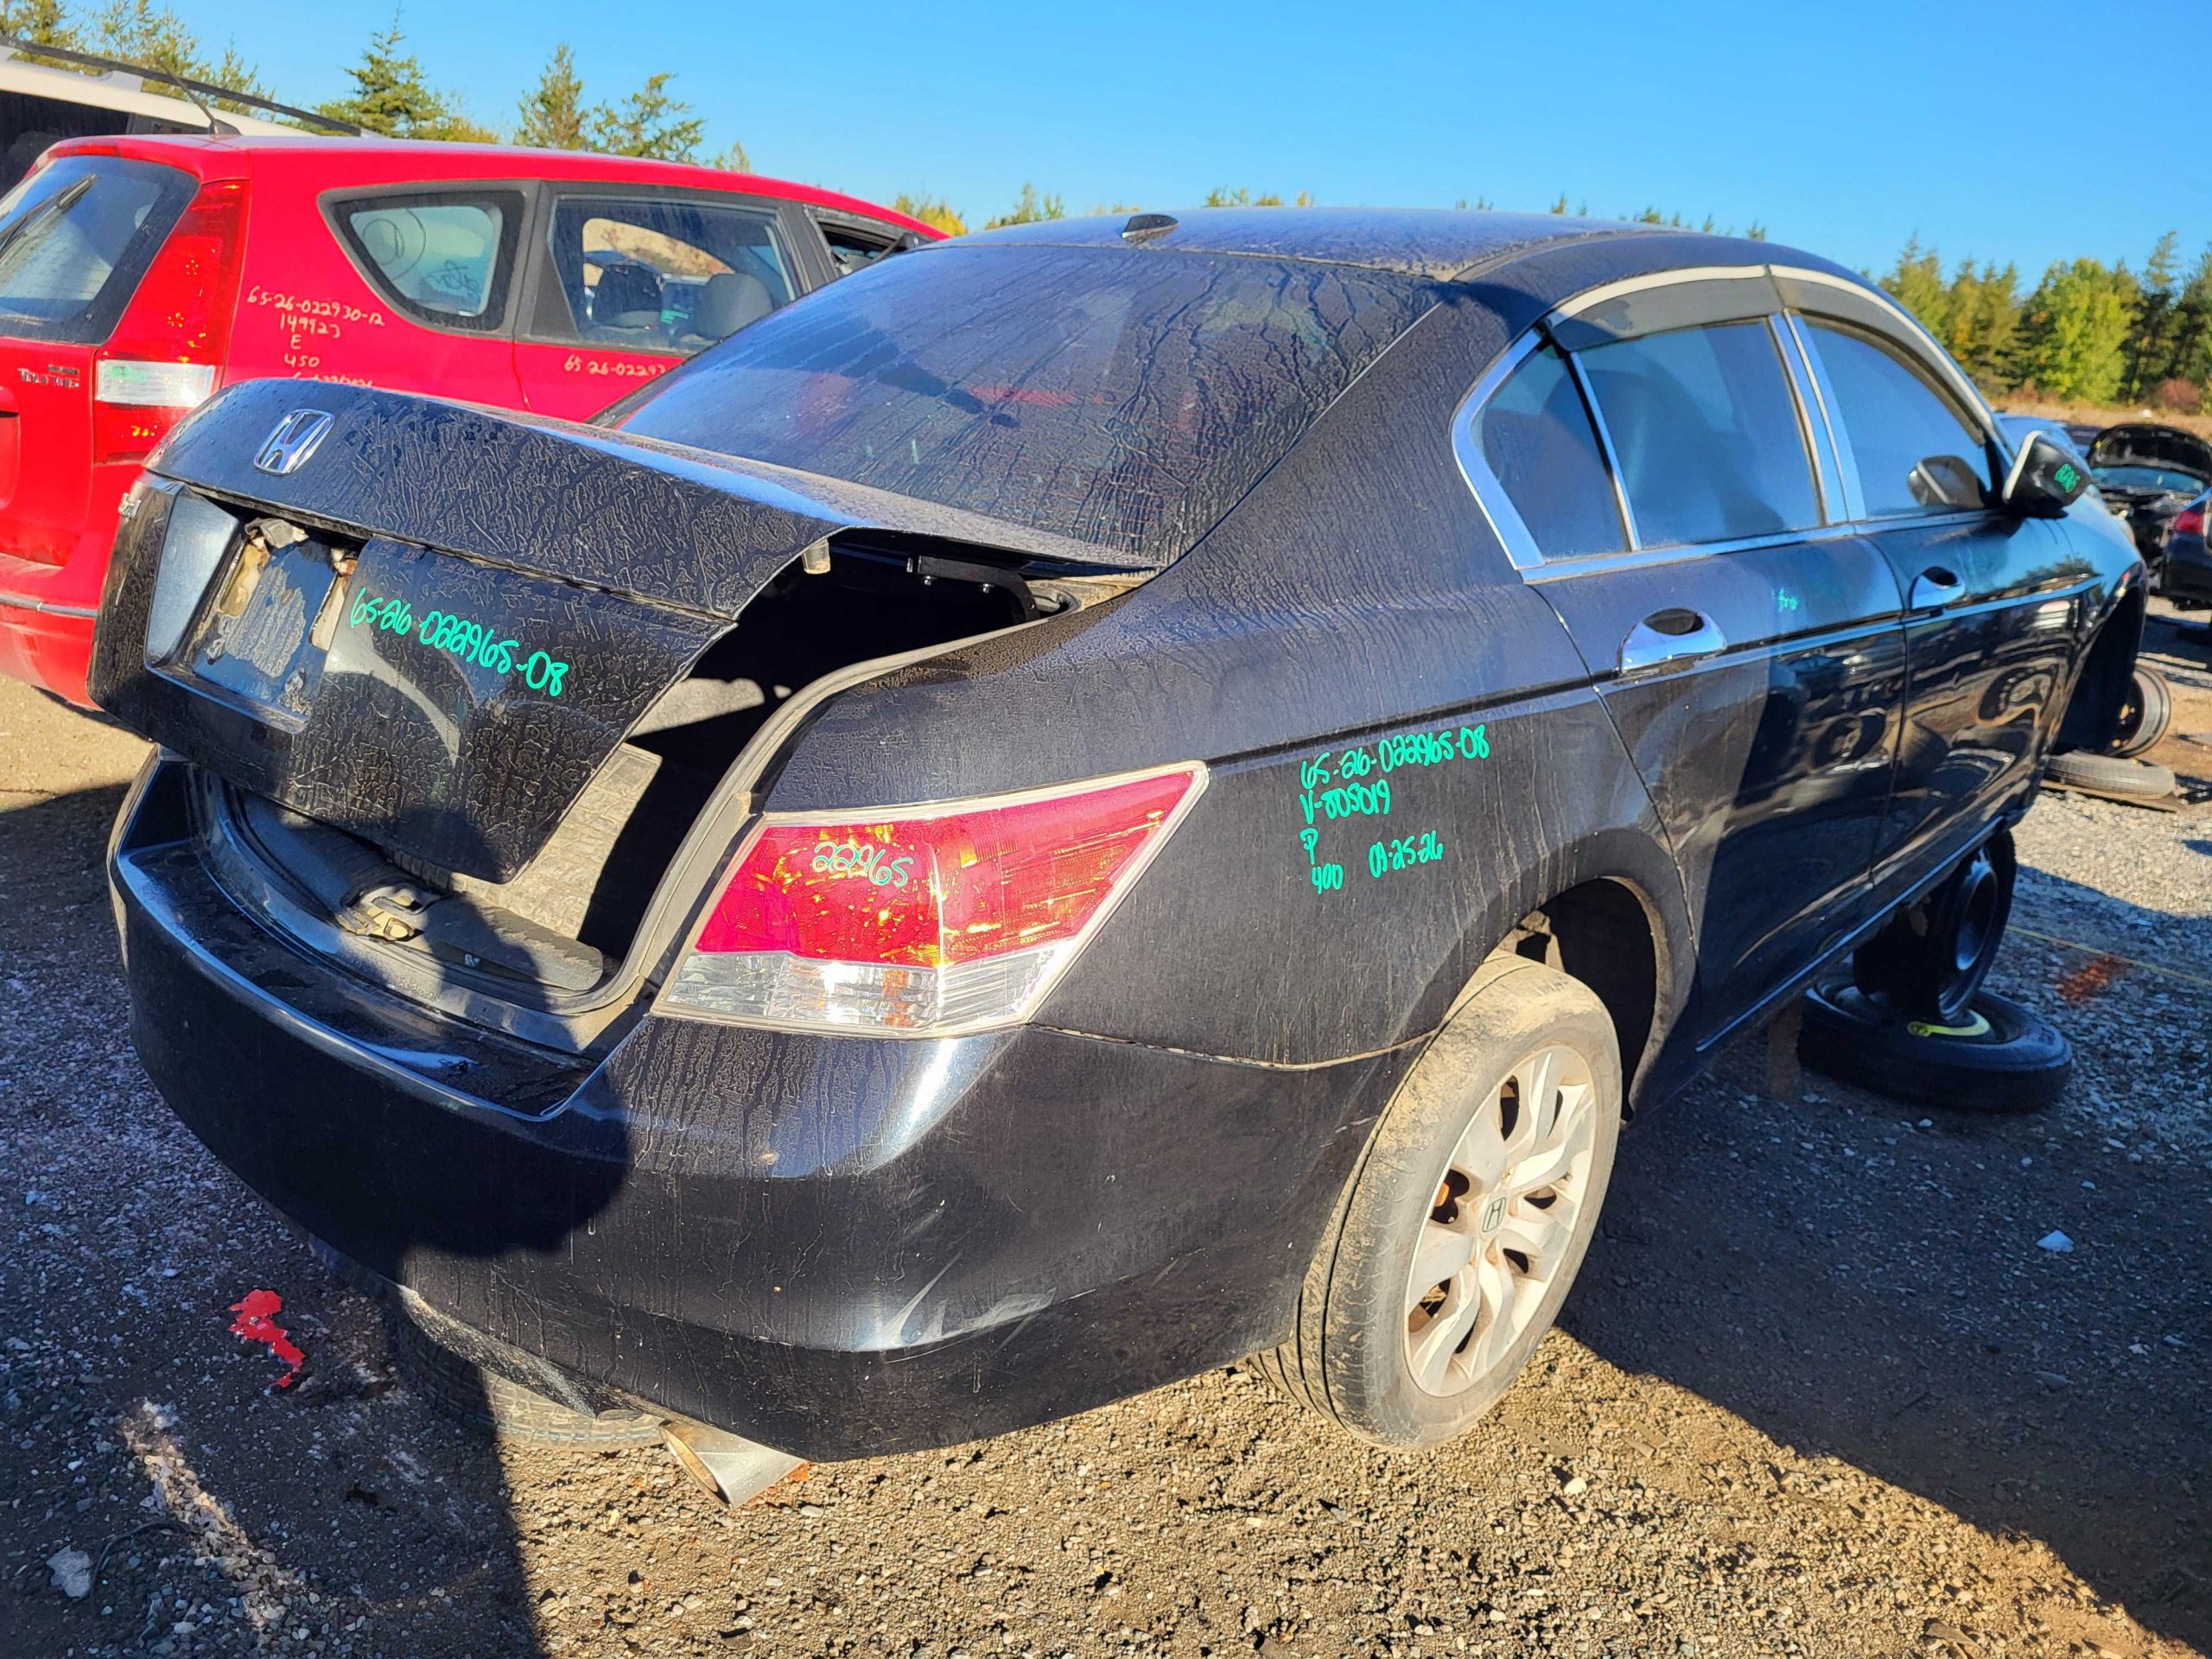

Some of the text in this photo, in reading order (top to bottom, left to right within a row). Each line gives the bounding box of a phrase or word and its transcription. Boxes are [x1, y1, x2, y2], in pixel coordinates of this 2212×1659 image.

[290, 334, 302, 350] E
[283, 353, 321, 368] 450
[811, 841, 914, 888] 22965
[1311, 862, 1344, 895] 400
